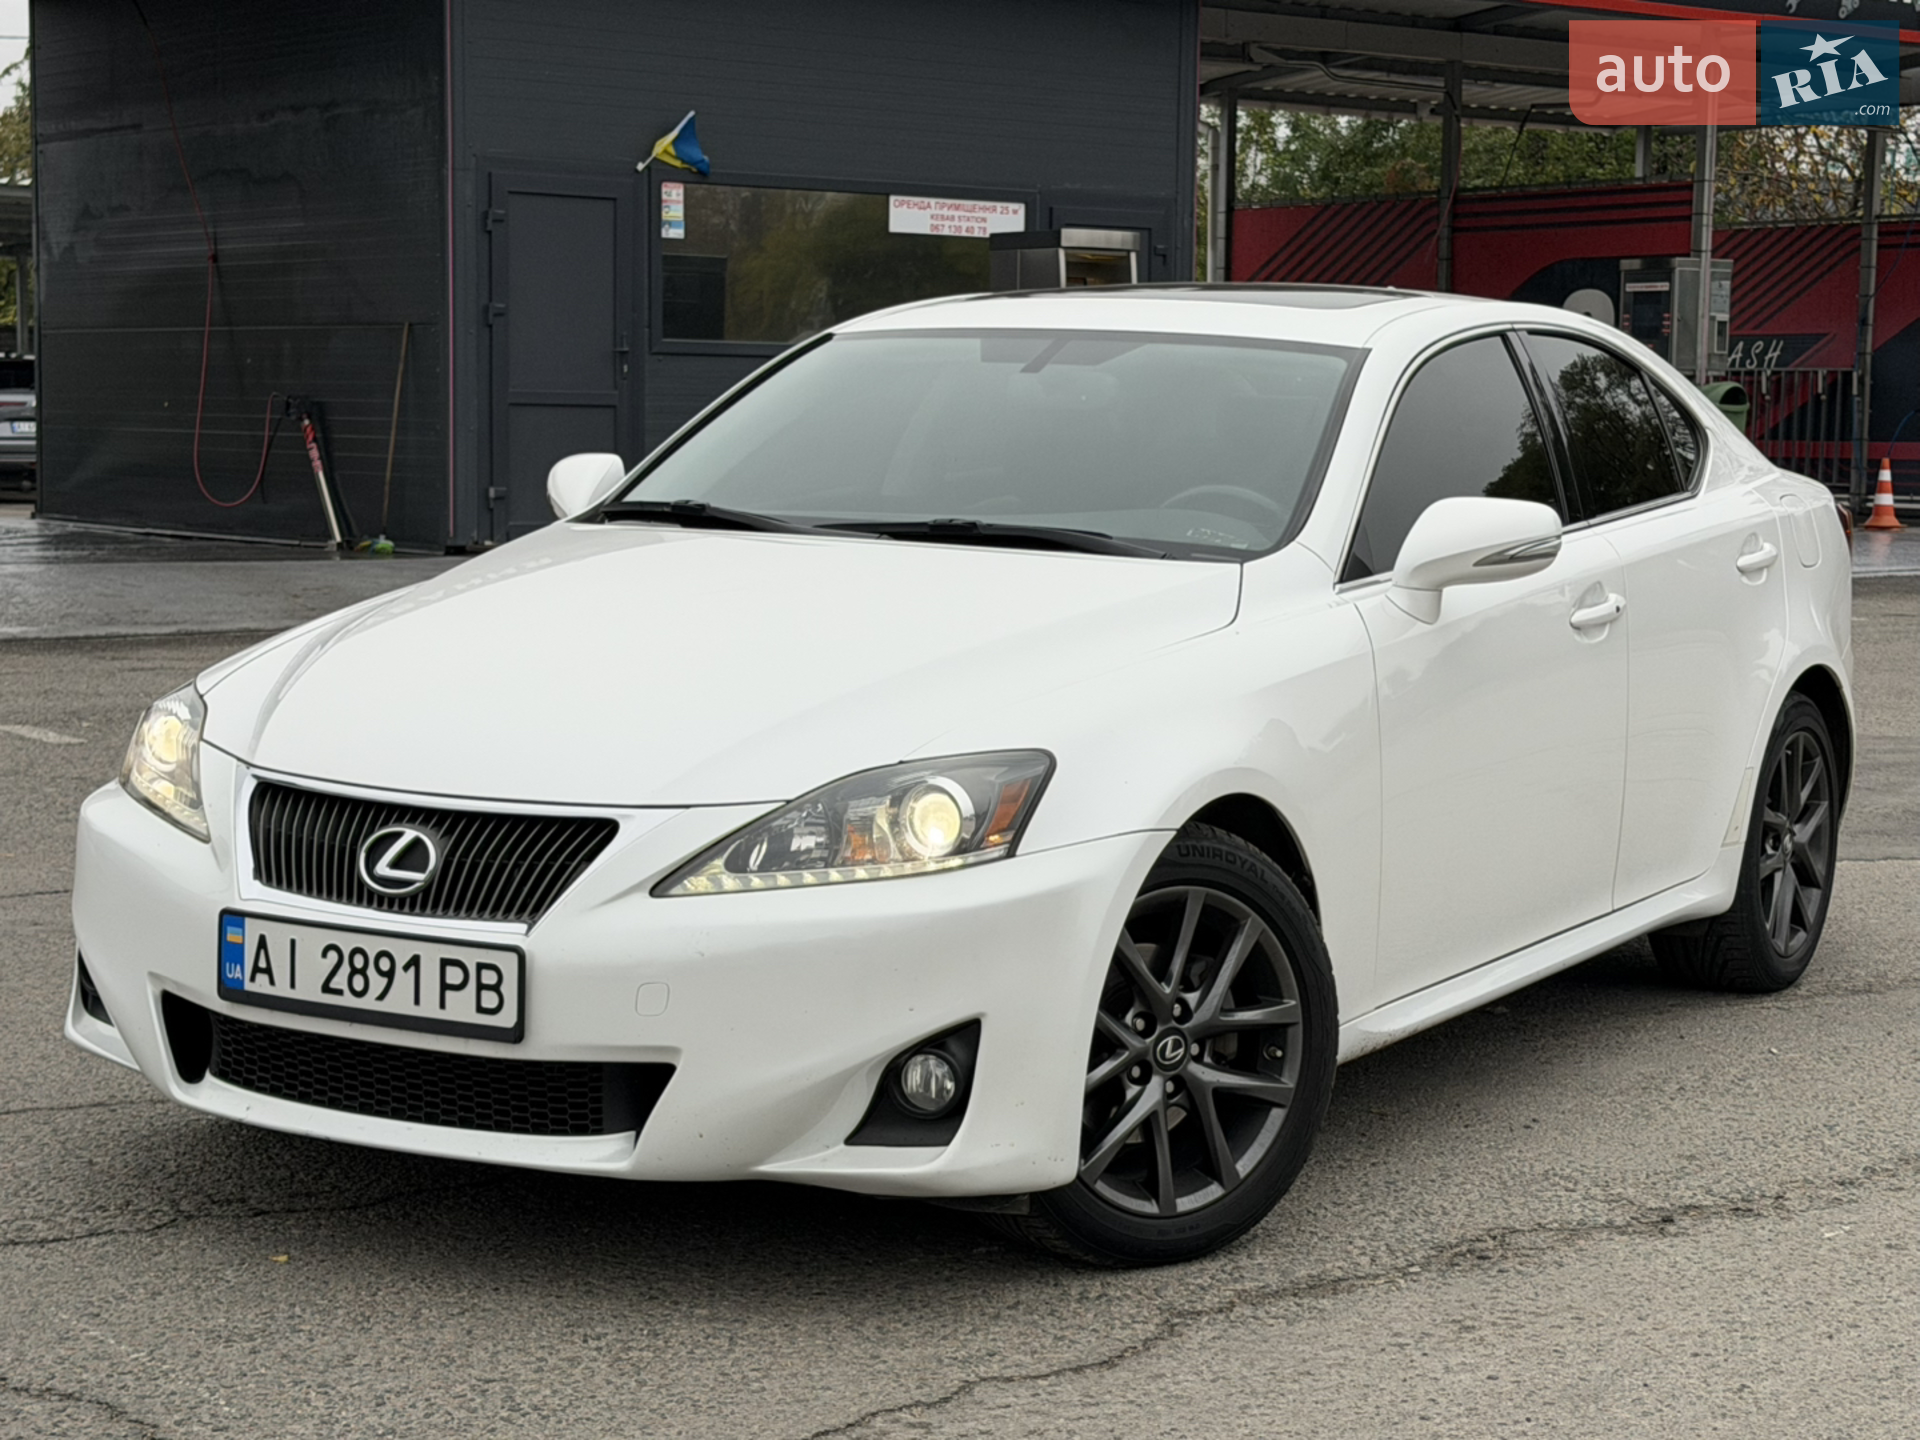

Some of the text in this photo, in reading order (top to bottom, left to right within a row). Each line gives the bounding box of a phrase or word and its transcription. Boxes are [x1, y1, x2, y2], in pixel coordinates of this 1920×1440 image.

[892, 198, 932, 211] ОРЕНДА
[934, 201, 998, 214] ПРИМІЩЕННЯ
[999, 205, 1010, 215] 25
[929, 213, 988, 225] KEBAB STATION
[929, 223, 946, 233] 067
[1176, 843, 1269, 884] UNIROYAL
[225, 962, 243, 980] UA
